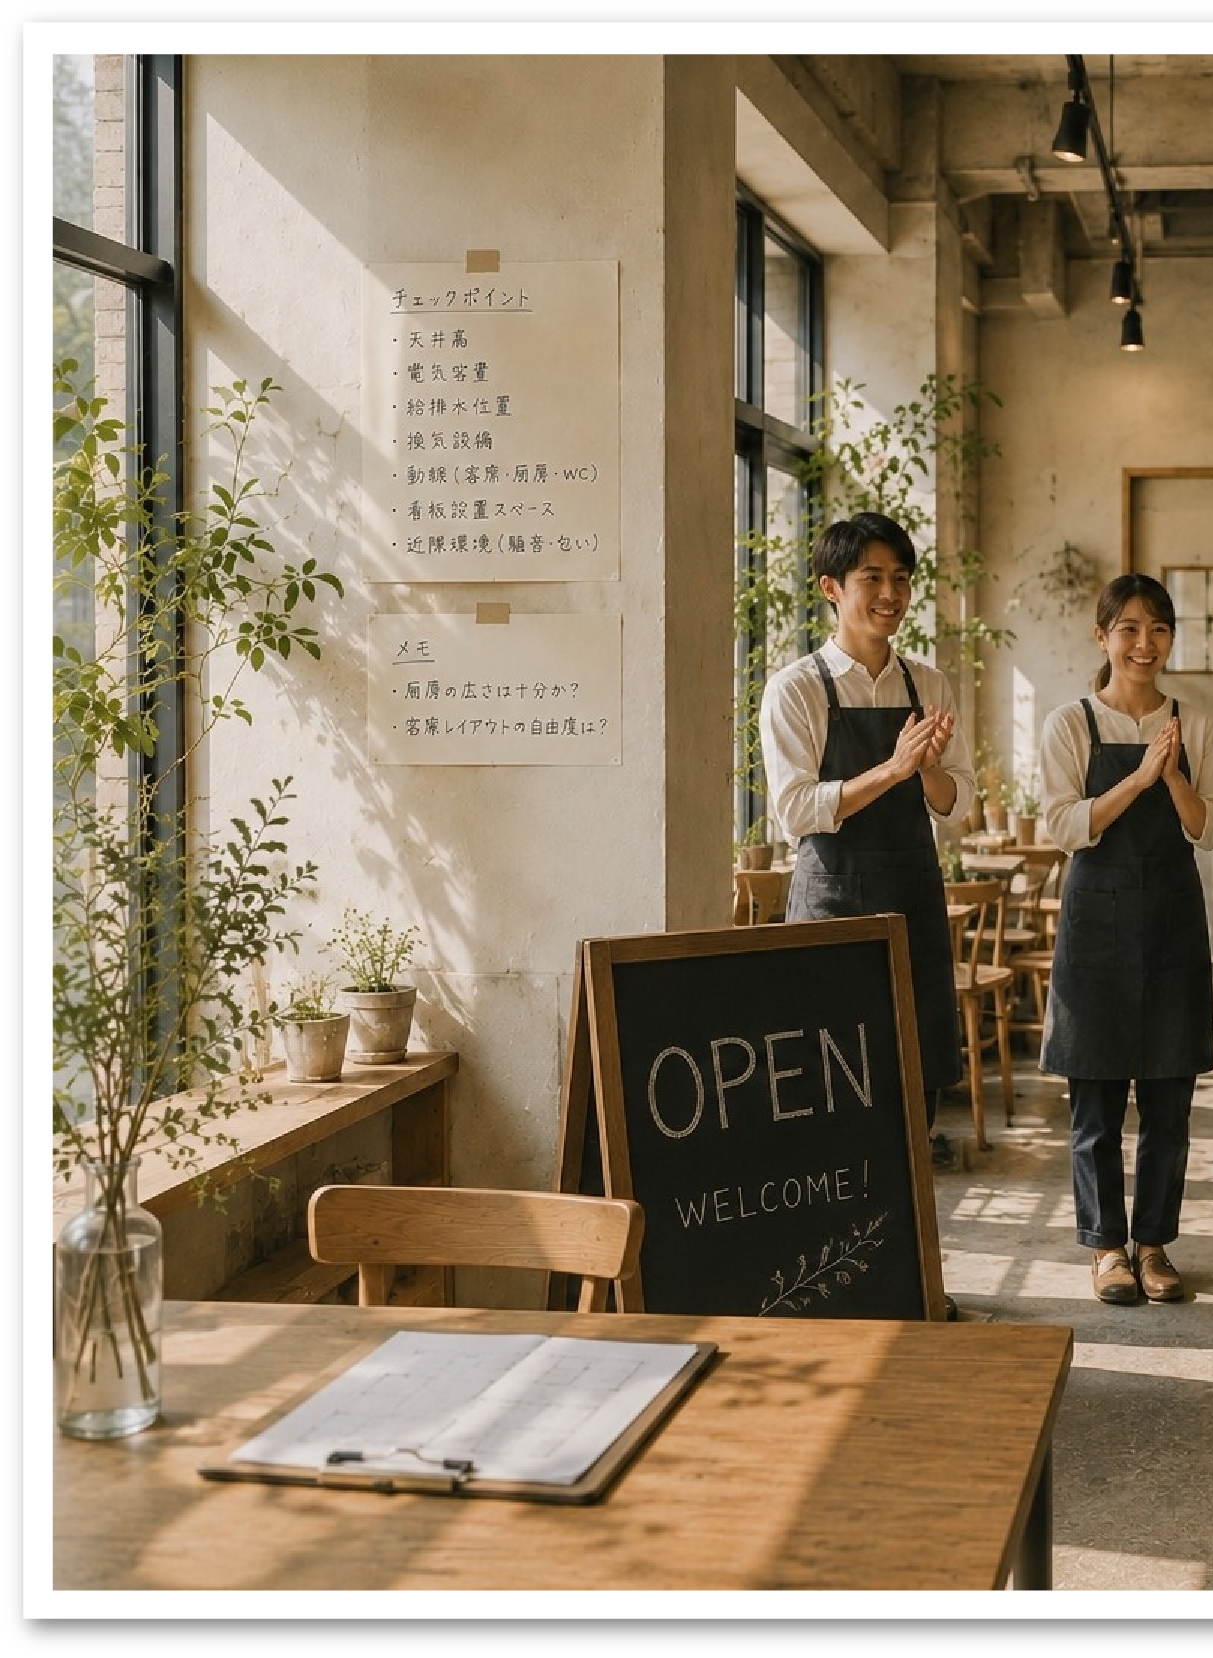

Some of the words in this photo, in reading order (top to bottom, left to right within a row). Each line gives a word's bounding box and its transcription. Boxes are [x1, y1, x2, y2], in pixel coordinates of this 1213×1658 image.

[393, 287, 529, 308] チェックポイント
[409, 328, 468, 349] 天井高
[407, 394, 512, 417] 給排水位置
[407, 499, 555, 521] 看板設置スペース
[397, 640, 430, 657] メモ
[648, 1023, 873, 1139] OPEN
[674, 1160, 869, 1228] WELCOME!
